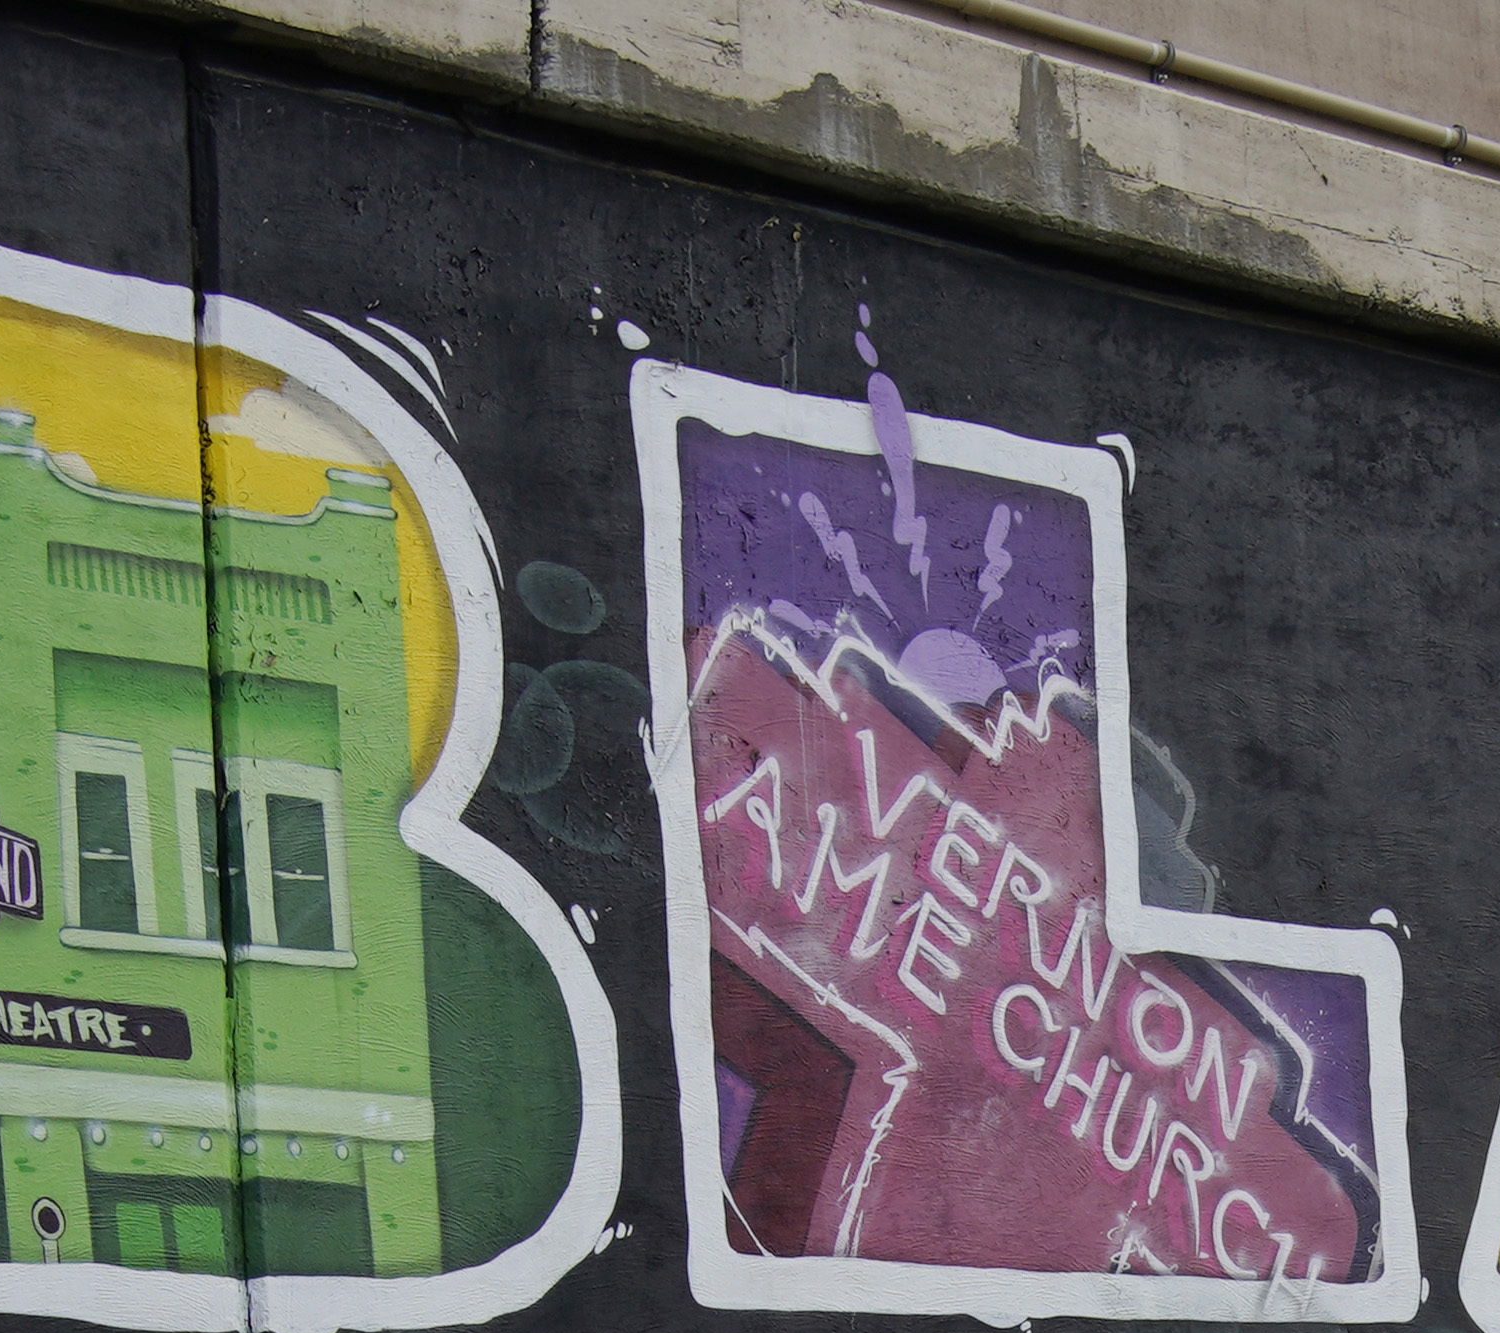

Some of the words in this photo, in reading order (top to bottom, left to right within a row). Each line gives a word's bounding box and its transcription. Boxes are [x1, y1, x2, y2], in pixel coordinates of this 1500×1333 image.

[704, 755, 973, 1014] AME
[856, 727, 1266, 1140] VERNON
[990, 982, 1324, 1317] CHURCH
